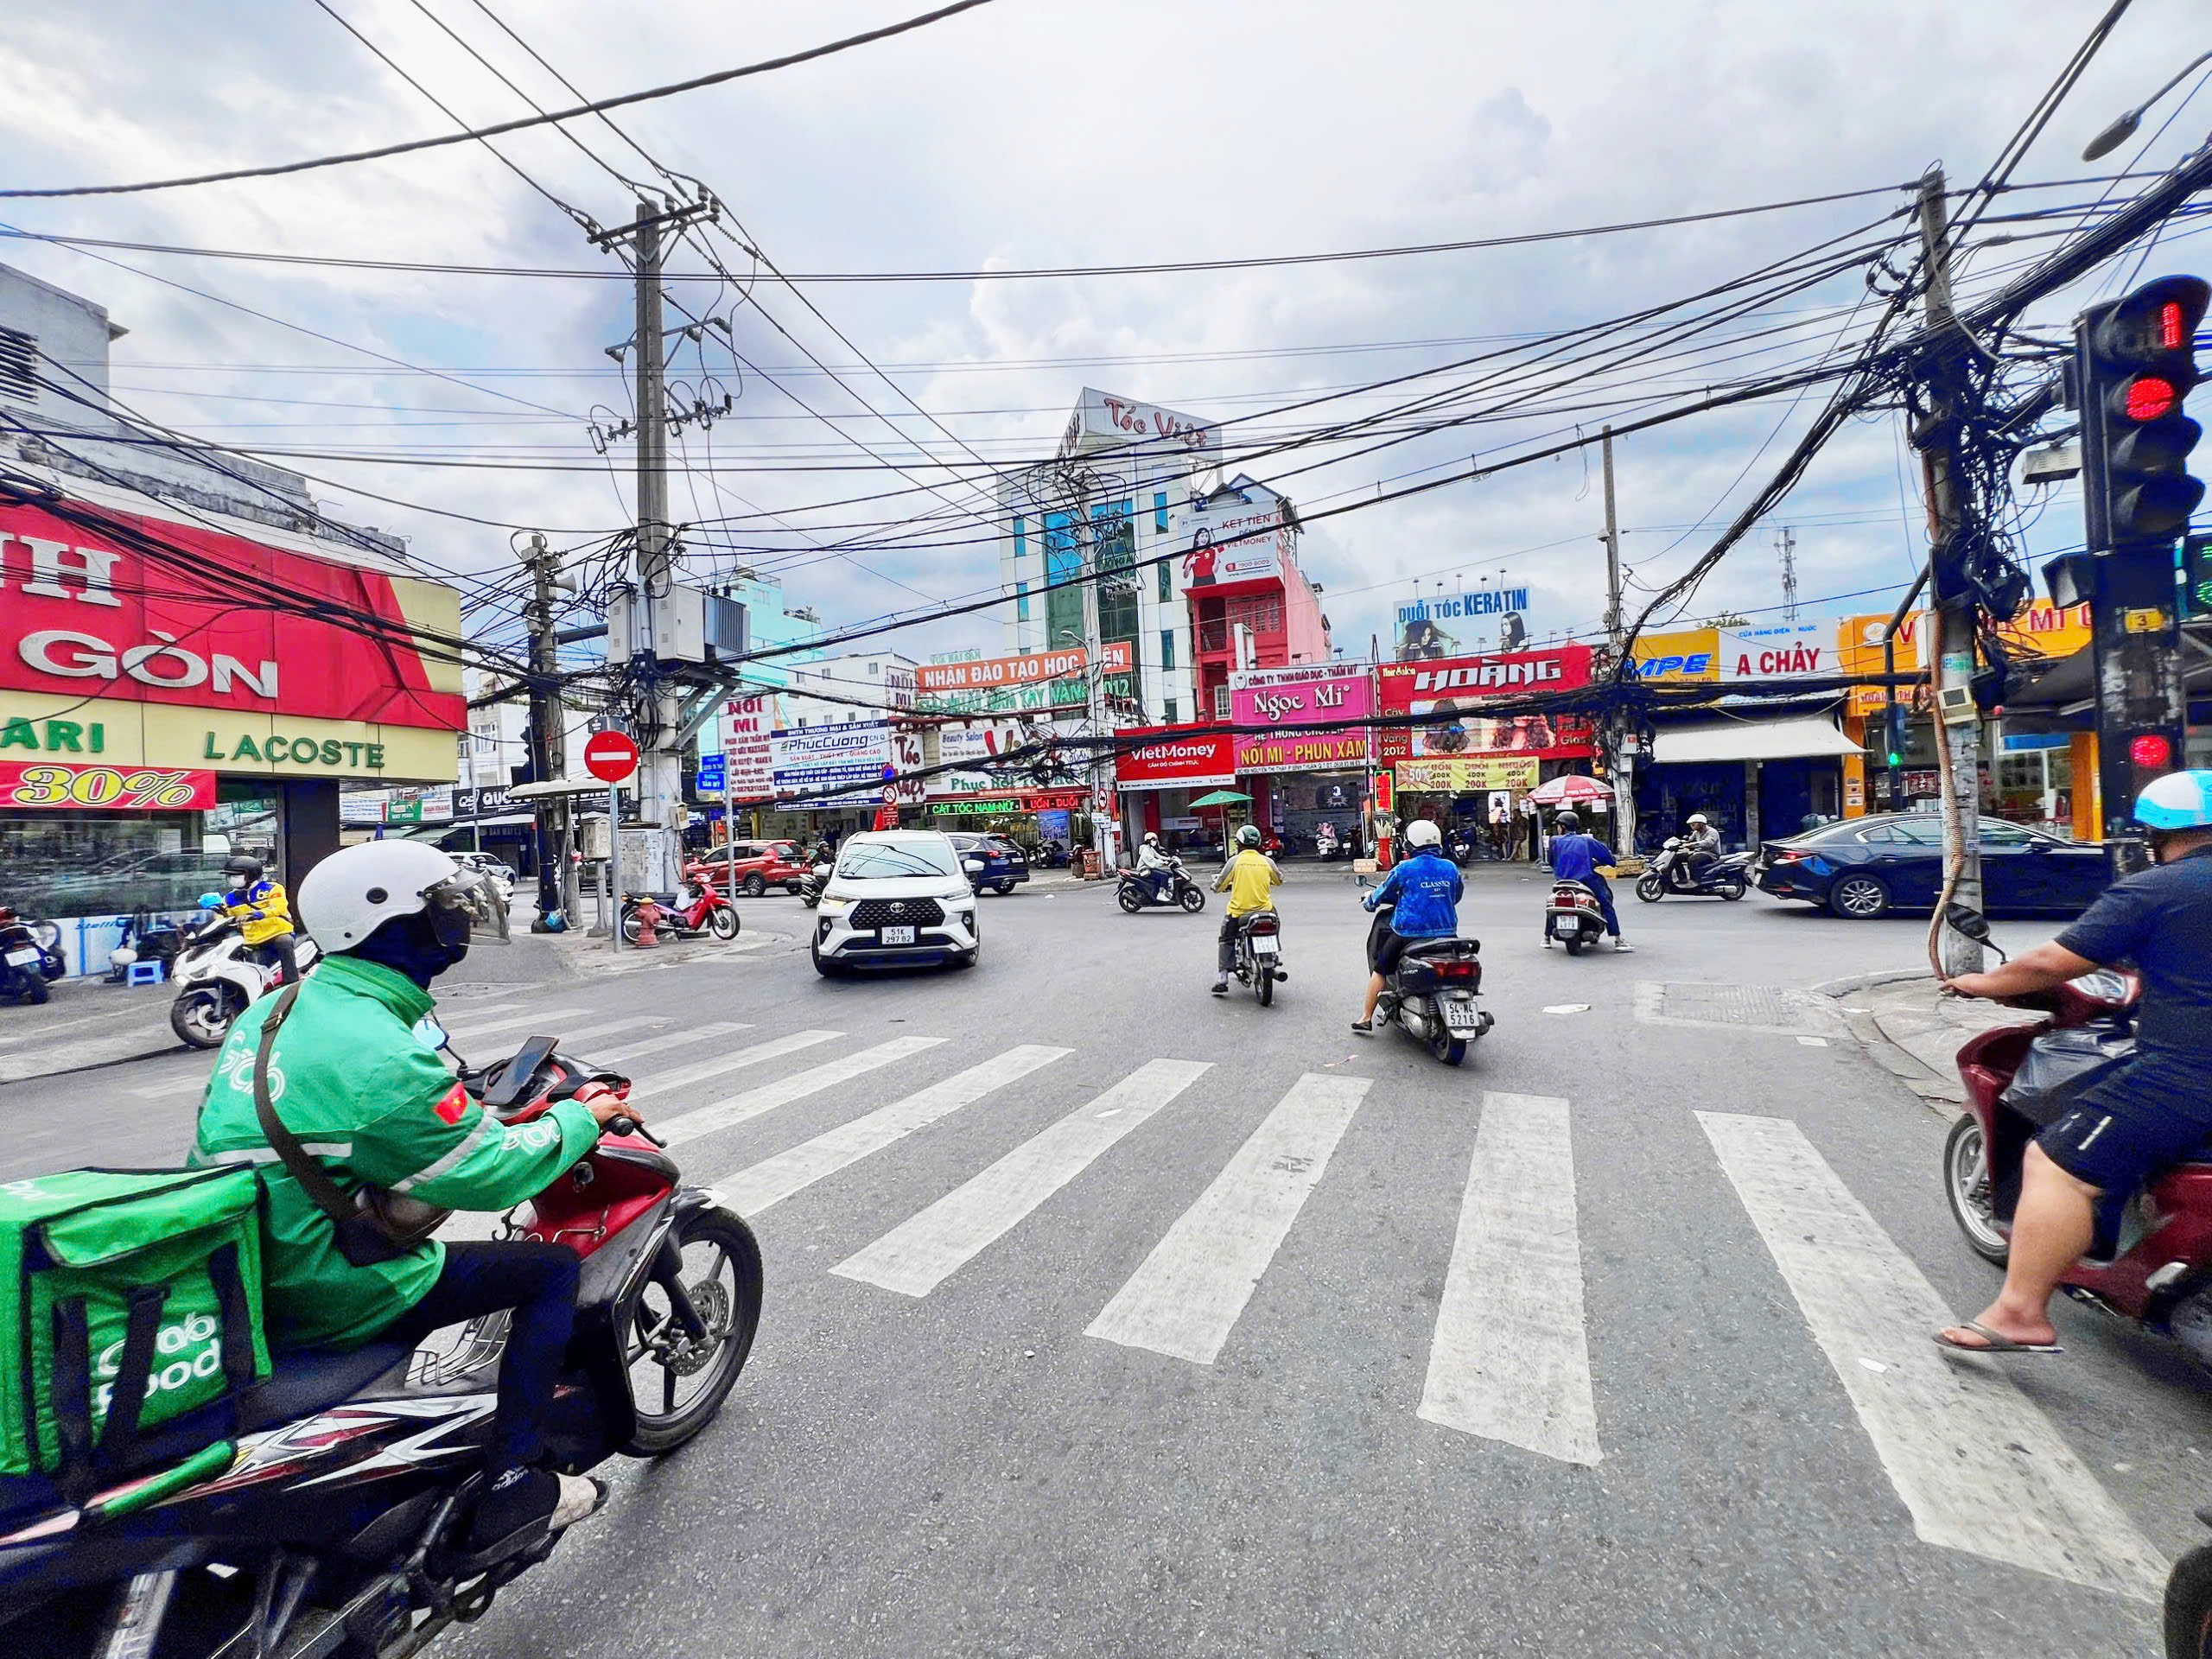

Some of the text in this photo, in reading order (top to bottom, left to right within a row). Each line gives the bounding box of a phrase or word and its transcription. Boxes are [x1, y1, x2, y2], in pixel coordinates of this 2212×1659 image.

[1103, 397, 1147, 433] Tóc
[1434, 600, 1462, 619] TÓC
[1464, 588, 1528, 616] KERATIN
[2137, 614, 2148, 626] 3
[18, 629, 278, 698] GÒN
[1736, 641, 1821, 677] A CHẢY
[925, 665, 967, 690] NHẬN
[970, 662, 1003, 683] ĐÀO
[1007, 658, 1039, 681] TẠO
[1414, 658, 1562, 692] HOÀNG
[895, 692, 912, 706] MI
[1254, 683, 1344, 721] Ngọc Mi
[733, 717, 759, 734] MI
[942, 732, 983, 745] Beauty Salon
[204, 731, 386, 769] LACOSTE
[895, 736, 921, 765] Tóc
[1241, 742, 1264, 766] NỐI
[1267, 746, 1284, 764] MI
[1295, 742, 1332, 761] PHUN
[1337, 737, 1366, 759] XĂM
[1383, 747, 1407, 757] 2012
[13, 766, 197, 807] 30%
[1465, 780, 1487, 789] 200K
[1505, 778, 1528, 788] 200K
[952, 800, 974, 812] TÓC
[1451, 1014, 1475, 1025] 5216
